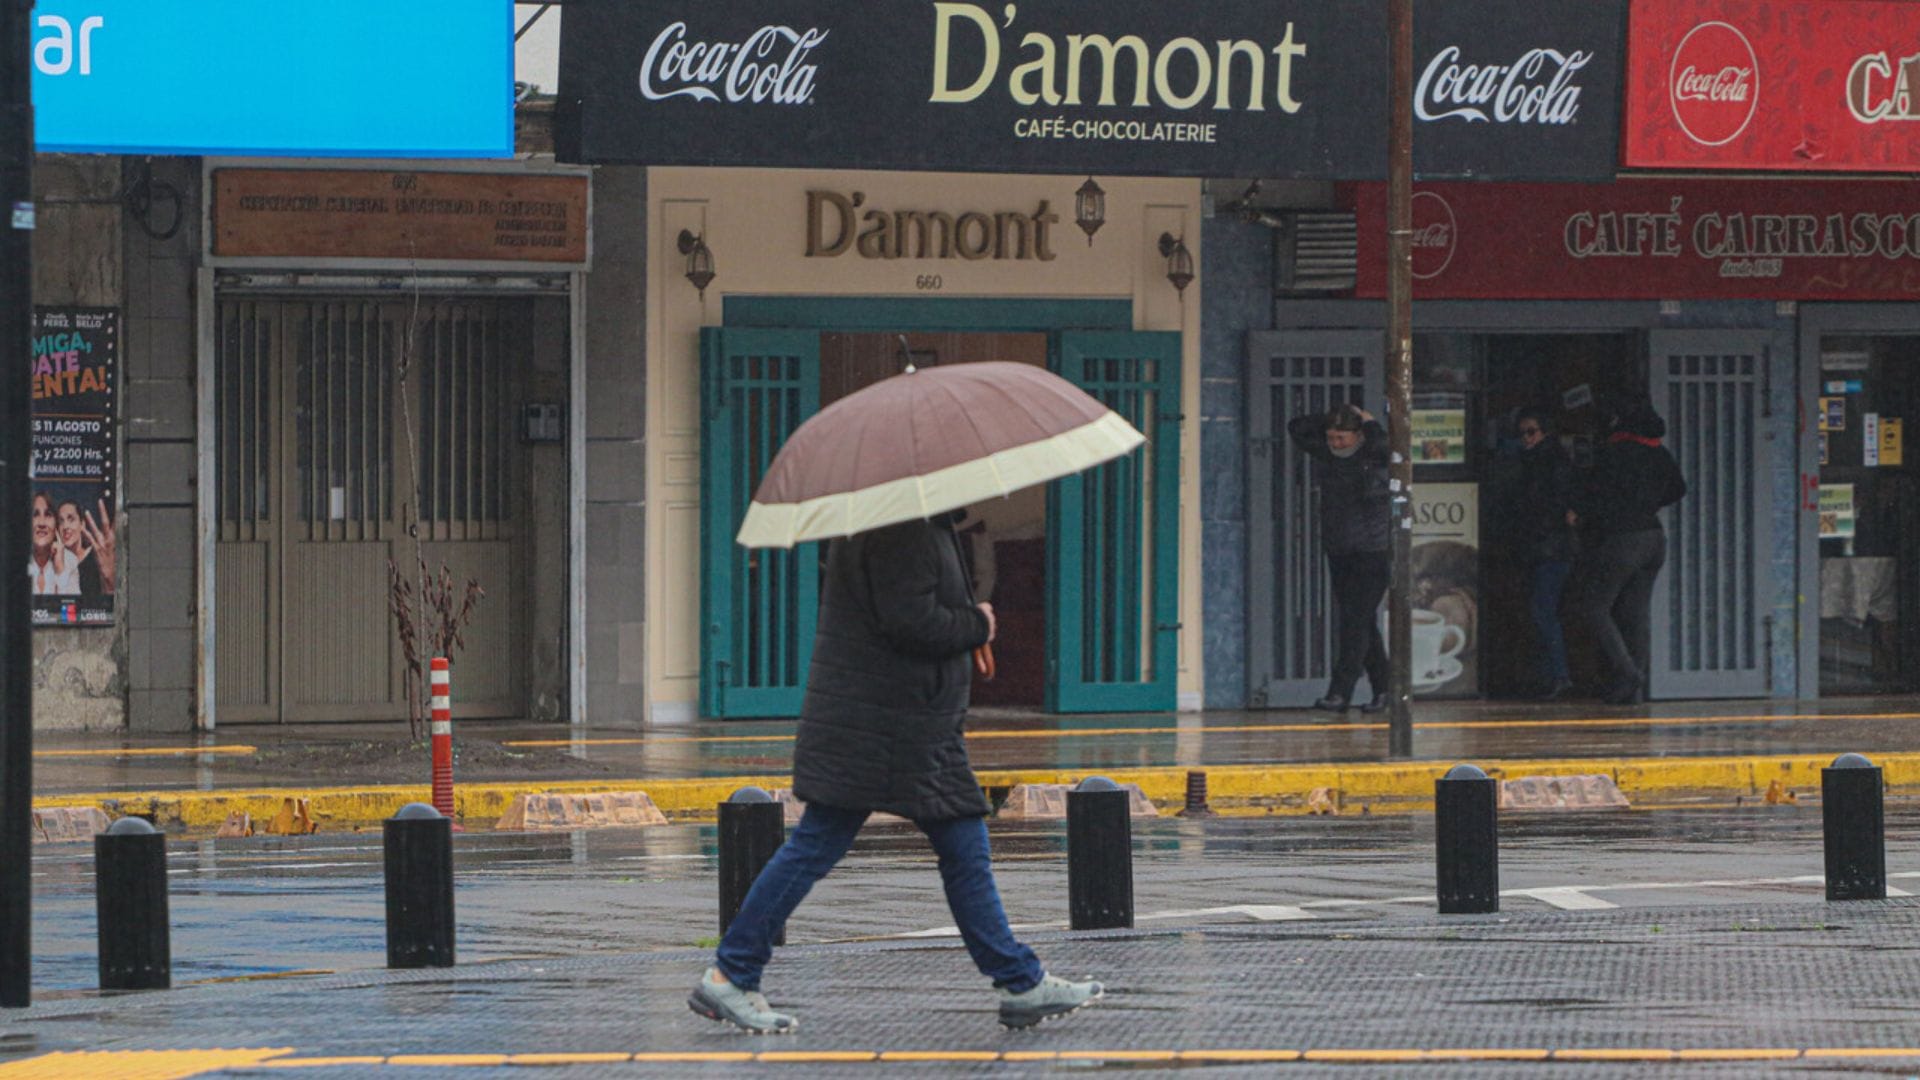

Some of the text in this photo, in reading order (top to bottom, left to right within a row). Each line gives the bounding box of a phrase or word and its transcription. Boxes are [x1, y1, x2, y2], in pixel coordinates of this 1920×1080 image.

[34, 14, 104, 75] ar
[638, 21, 829, 104] Coca-Cola
[928, 2, 1306, 113] D'amont
[1413, 45, 1594, 124] Coca-Cola
[1676, 64, 1752, 101] Coca-Cola
[1013, 115, 1217, 143] CAFÉ-CHOCOLATERIE
[804, 189, 1059, 261] D'amont
[1564, 195, 1683, 258] CAFÉ
[915, 275, 943, 290] 660
[32, 434, 82, 445] FUNCIONES
[55, 420, 101, 432] AGOSTO
[44, 449, 52, 461] y
[53, 448, 82, 459] 22:00
[84, 448, 103, 460] Hrs.
[66, 465, 84, 475] DEL
